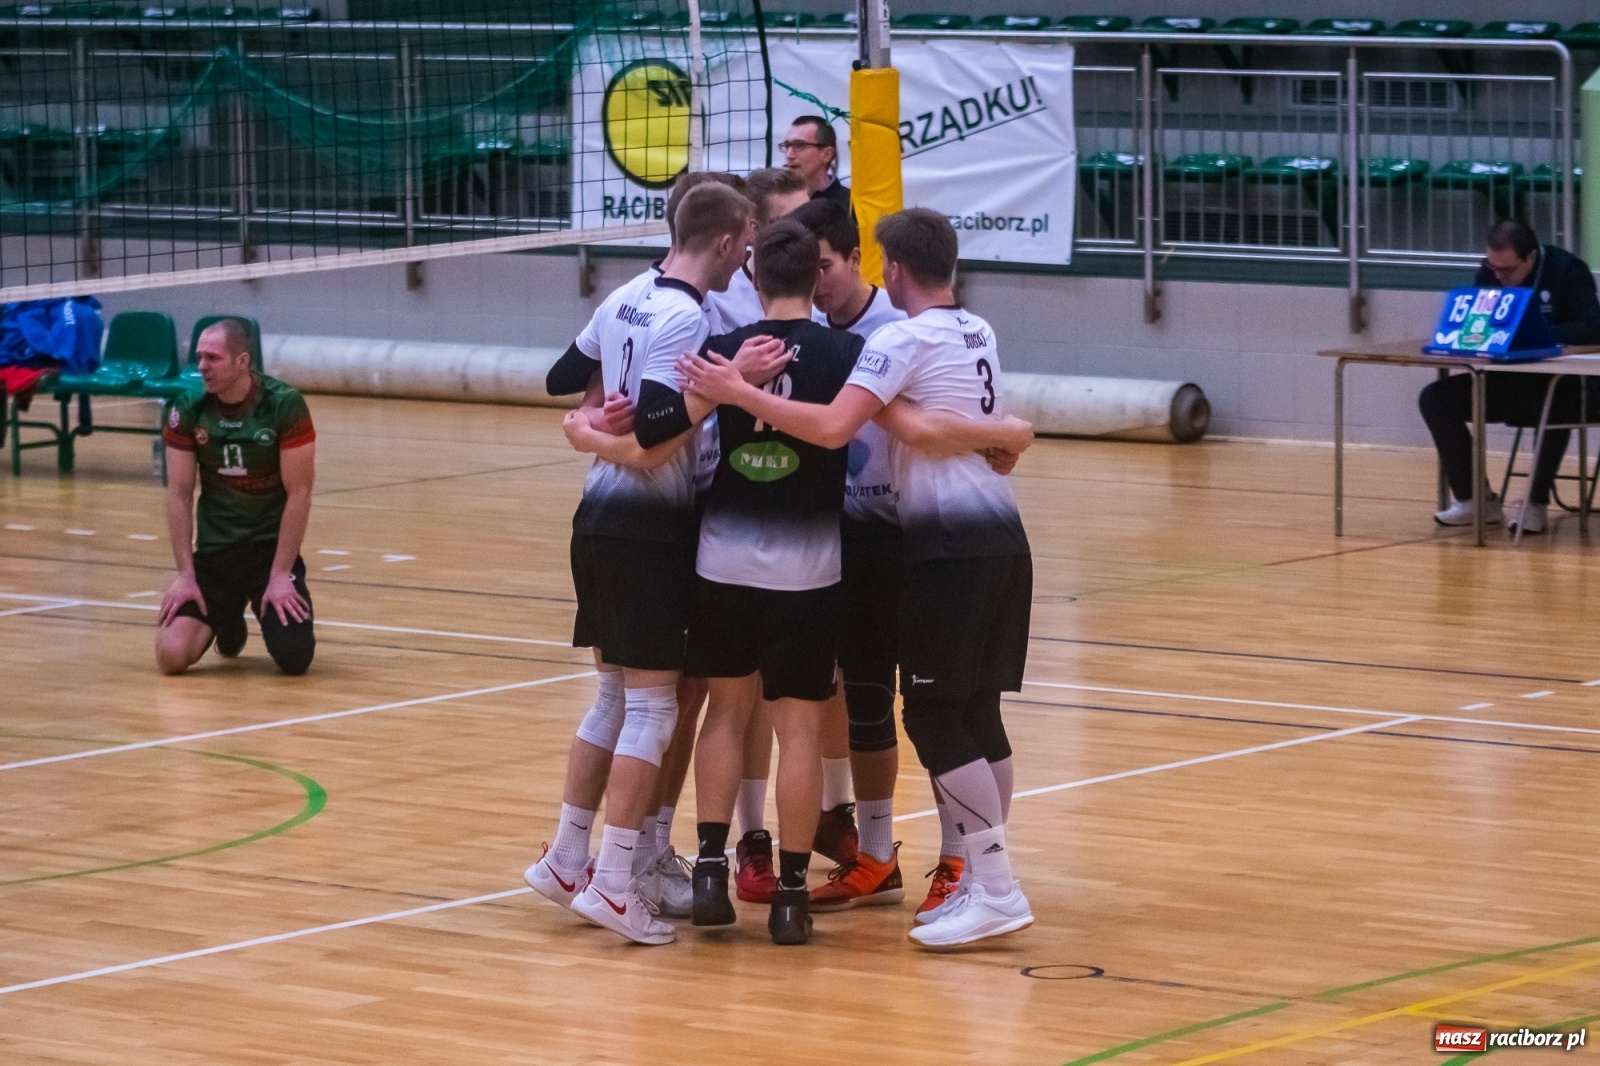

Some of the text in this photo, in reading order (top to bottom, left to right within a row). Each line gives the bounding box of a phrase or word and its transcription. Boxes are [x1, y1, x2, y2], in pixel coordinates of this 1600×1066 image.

[899, 75, 1042, 154] RZĄDKU!
[603, 195, 666, 220] RACIB
[1449, 294, 1473, 323] 15
[1494, 293, 1515, 321] 8
[963, 332, 987, 350] BUGAJ
[976, 358, 995, 415] 3
[647, 406, 674, 420] KIPSTA
[223, 443, 244, 470] 13
